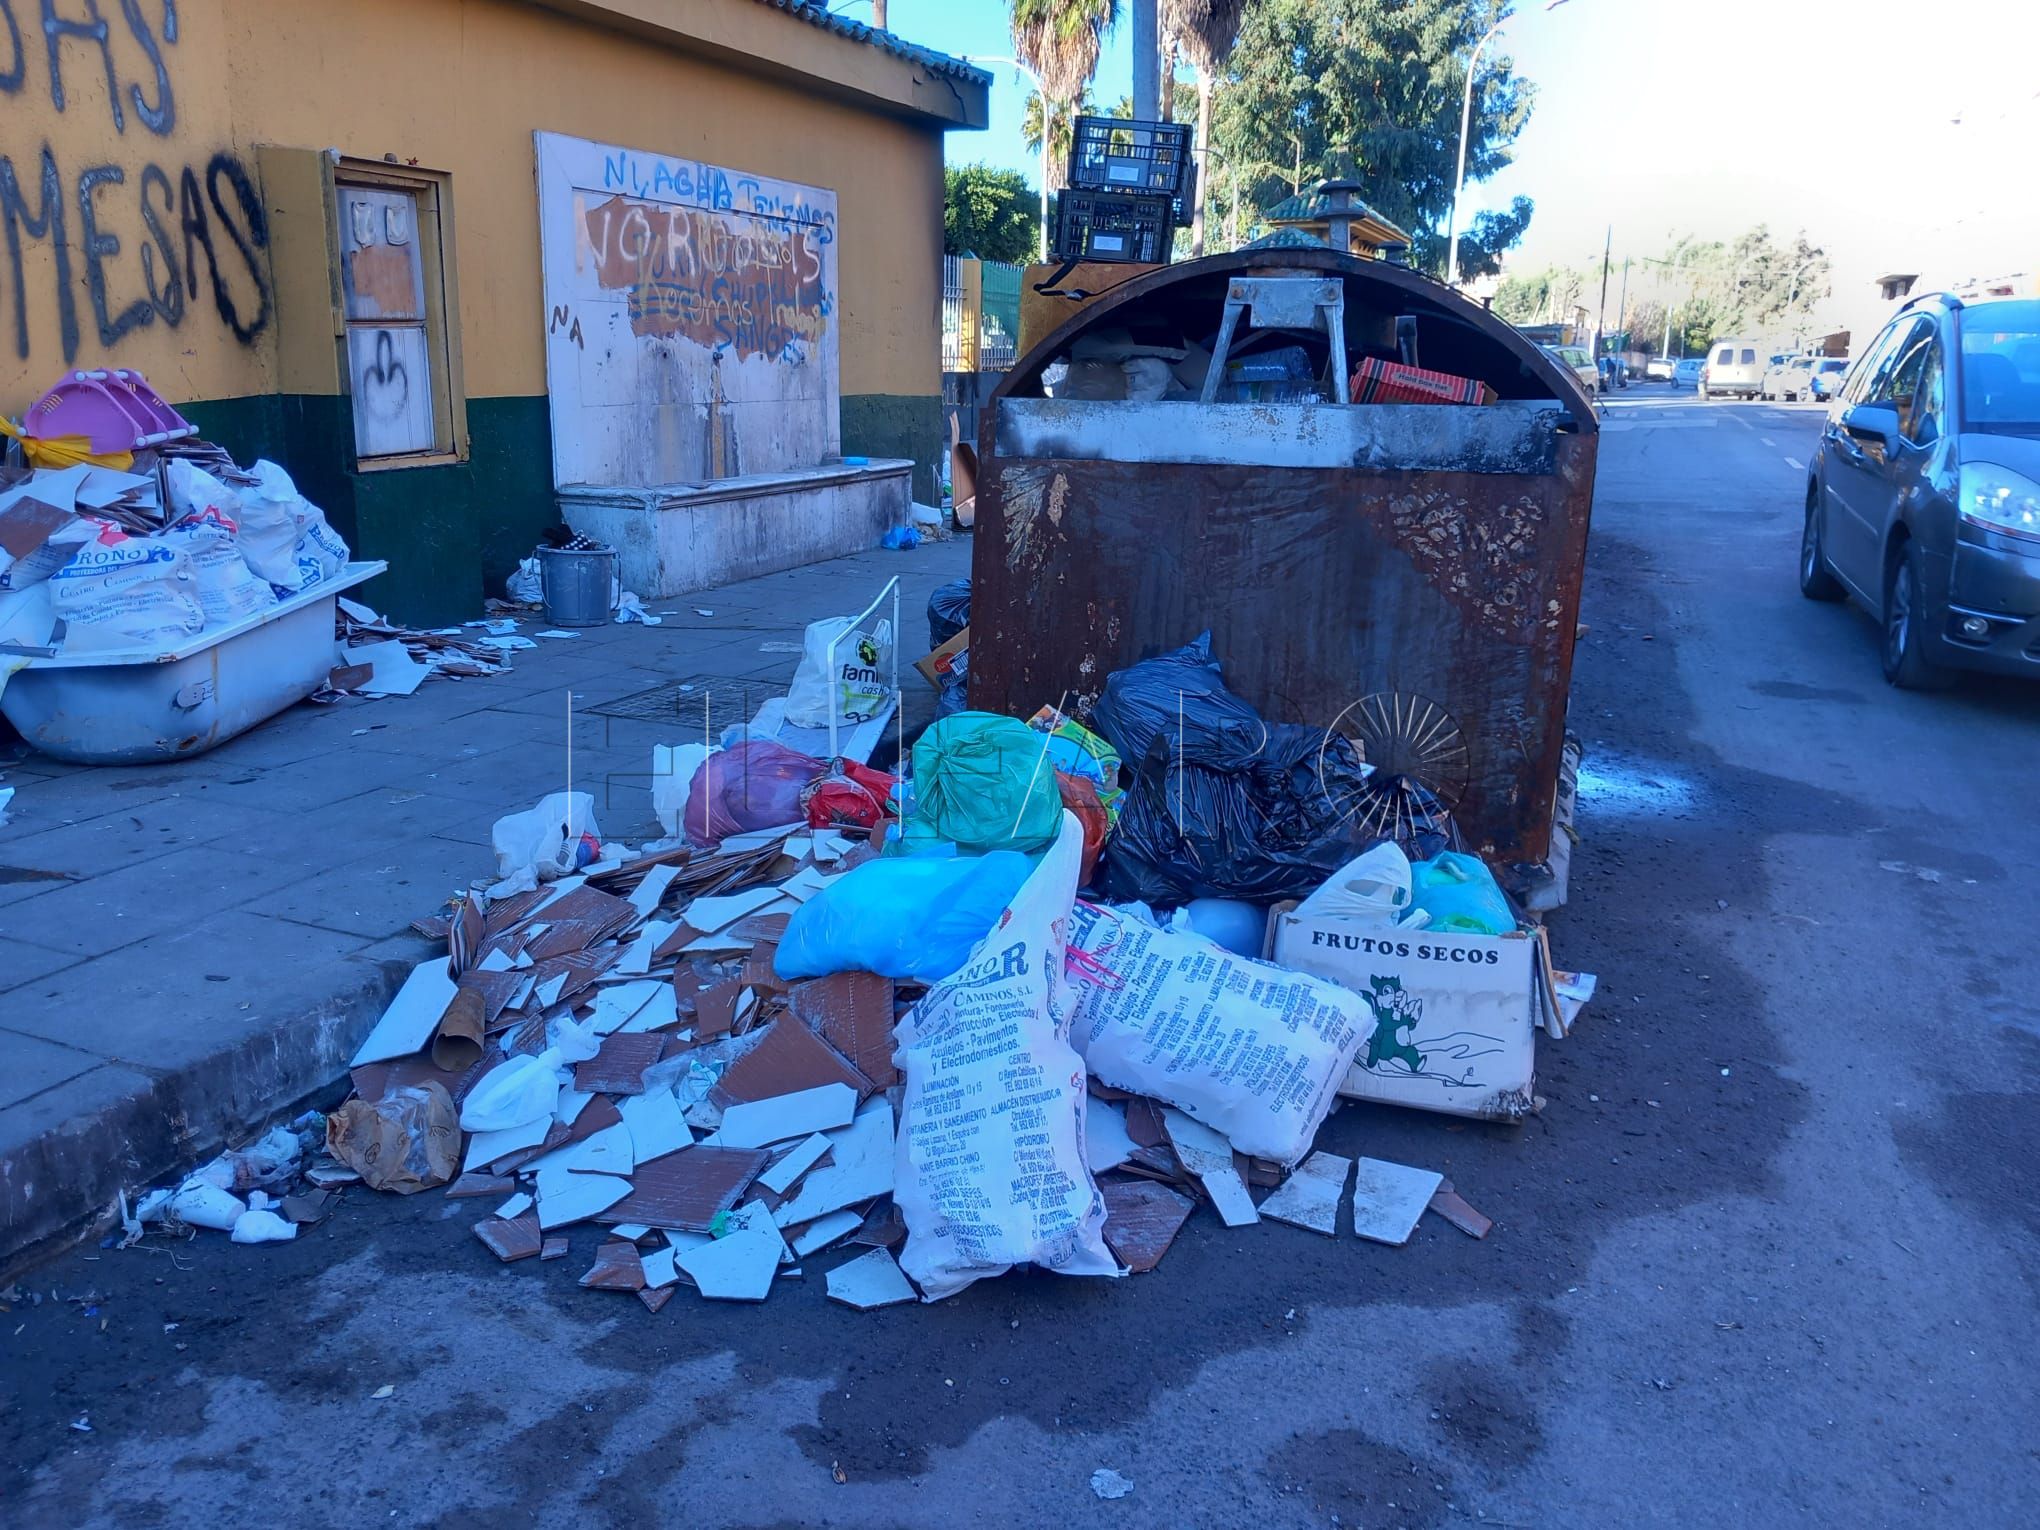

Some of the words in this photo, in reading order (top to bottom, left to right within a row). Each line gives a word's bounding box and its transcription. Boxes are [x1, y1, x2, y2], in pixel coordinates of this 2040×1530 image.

[1311, 930, 1410, 957] FRUTOS
[1416, 945, 1500, 965] SECOS
[1114, 992, 1139, 1023] Azulejos
[930, 1041, 965, 1061] Azulejos
[970, 1022, 1019, 1048] Pavimentos
[932, 1061, 938, 1077] y
[1008, 1052, 1031, 1065] CENTRO
[959, 1151, 980, 1166] CHINO
